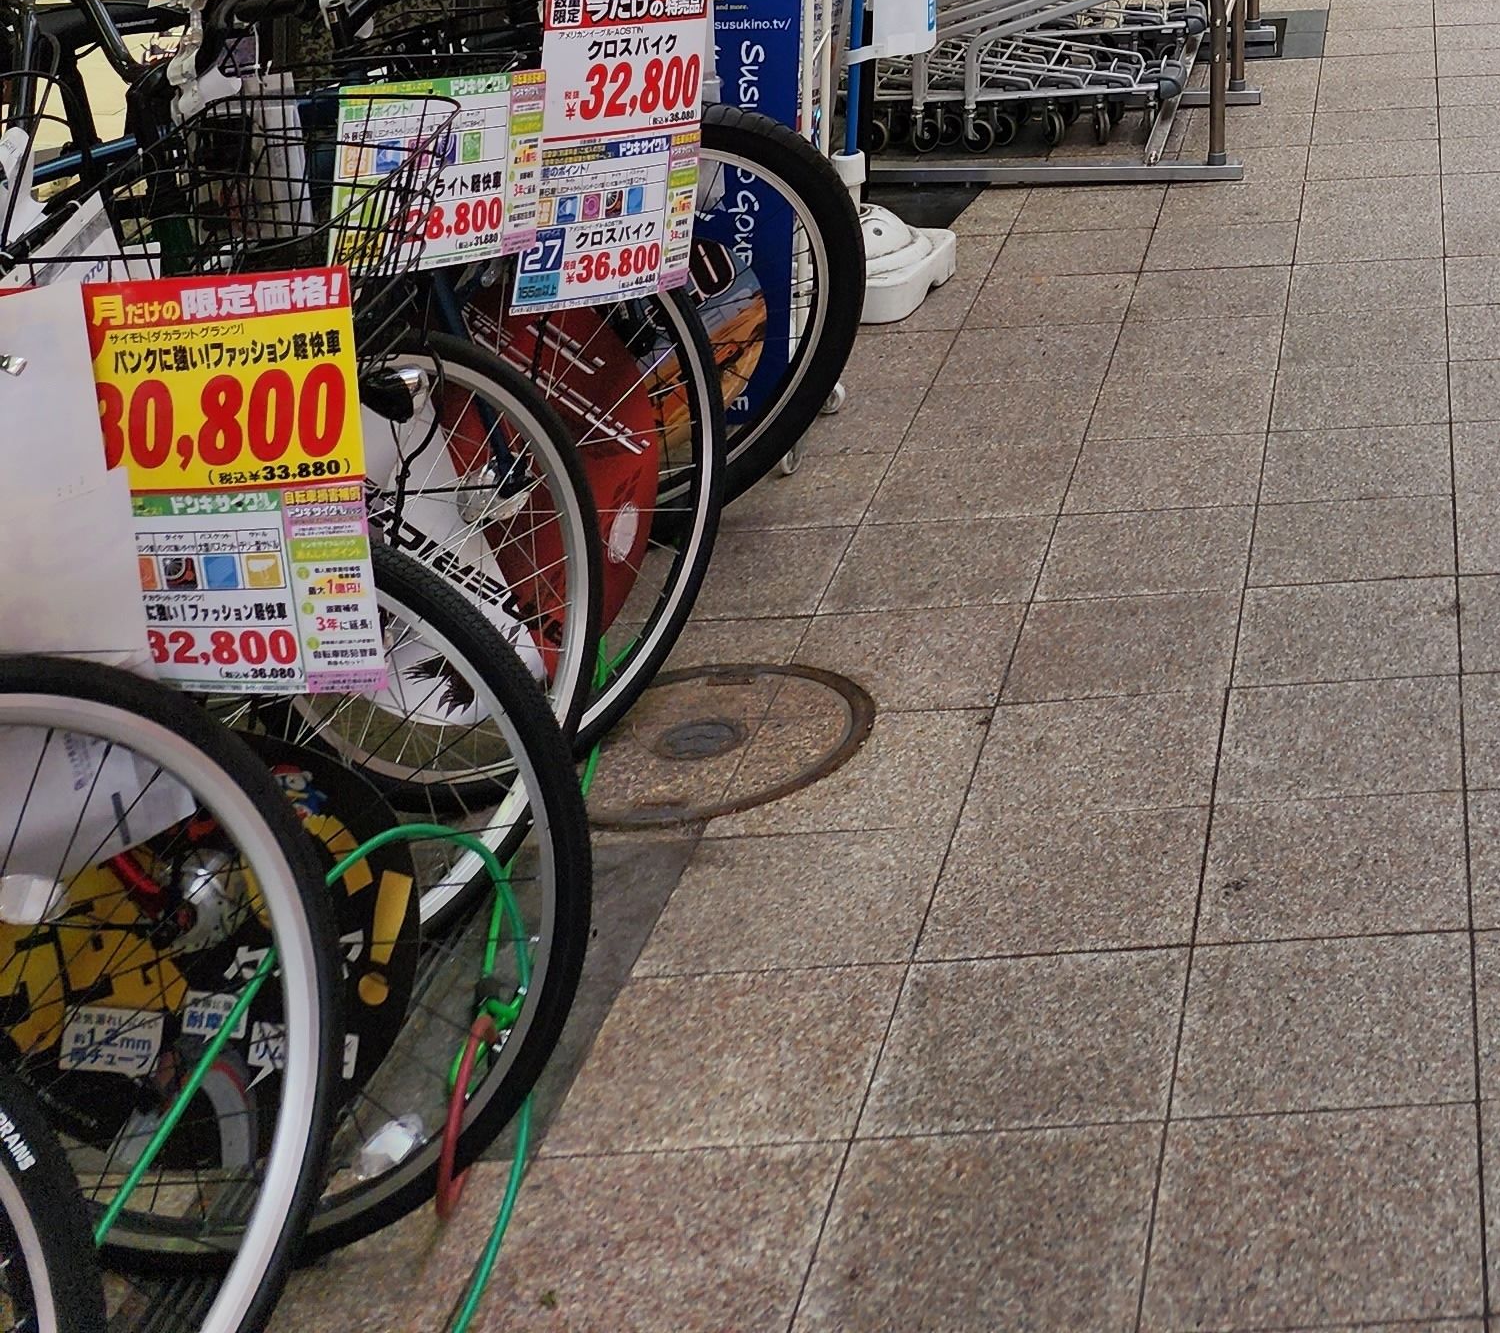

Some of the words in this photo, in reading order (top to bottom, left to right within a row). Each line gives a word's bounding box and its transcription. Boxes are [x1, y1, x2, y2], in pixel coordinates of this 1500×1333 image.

[552, 8, 581, 24] 限定
[587, 33, 678, 61] クロスバイク
[574, 220, 656, 250] クロスバイク
[523, 238, 563, 271] 27
[170, 493, 279, 515] ドンキサイクル
